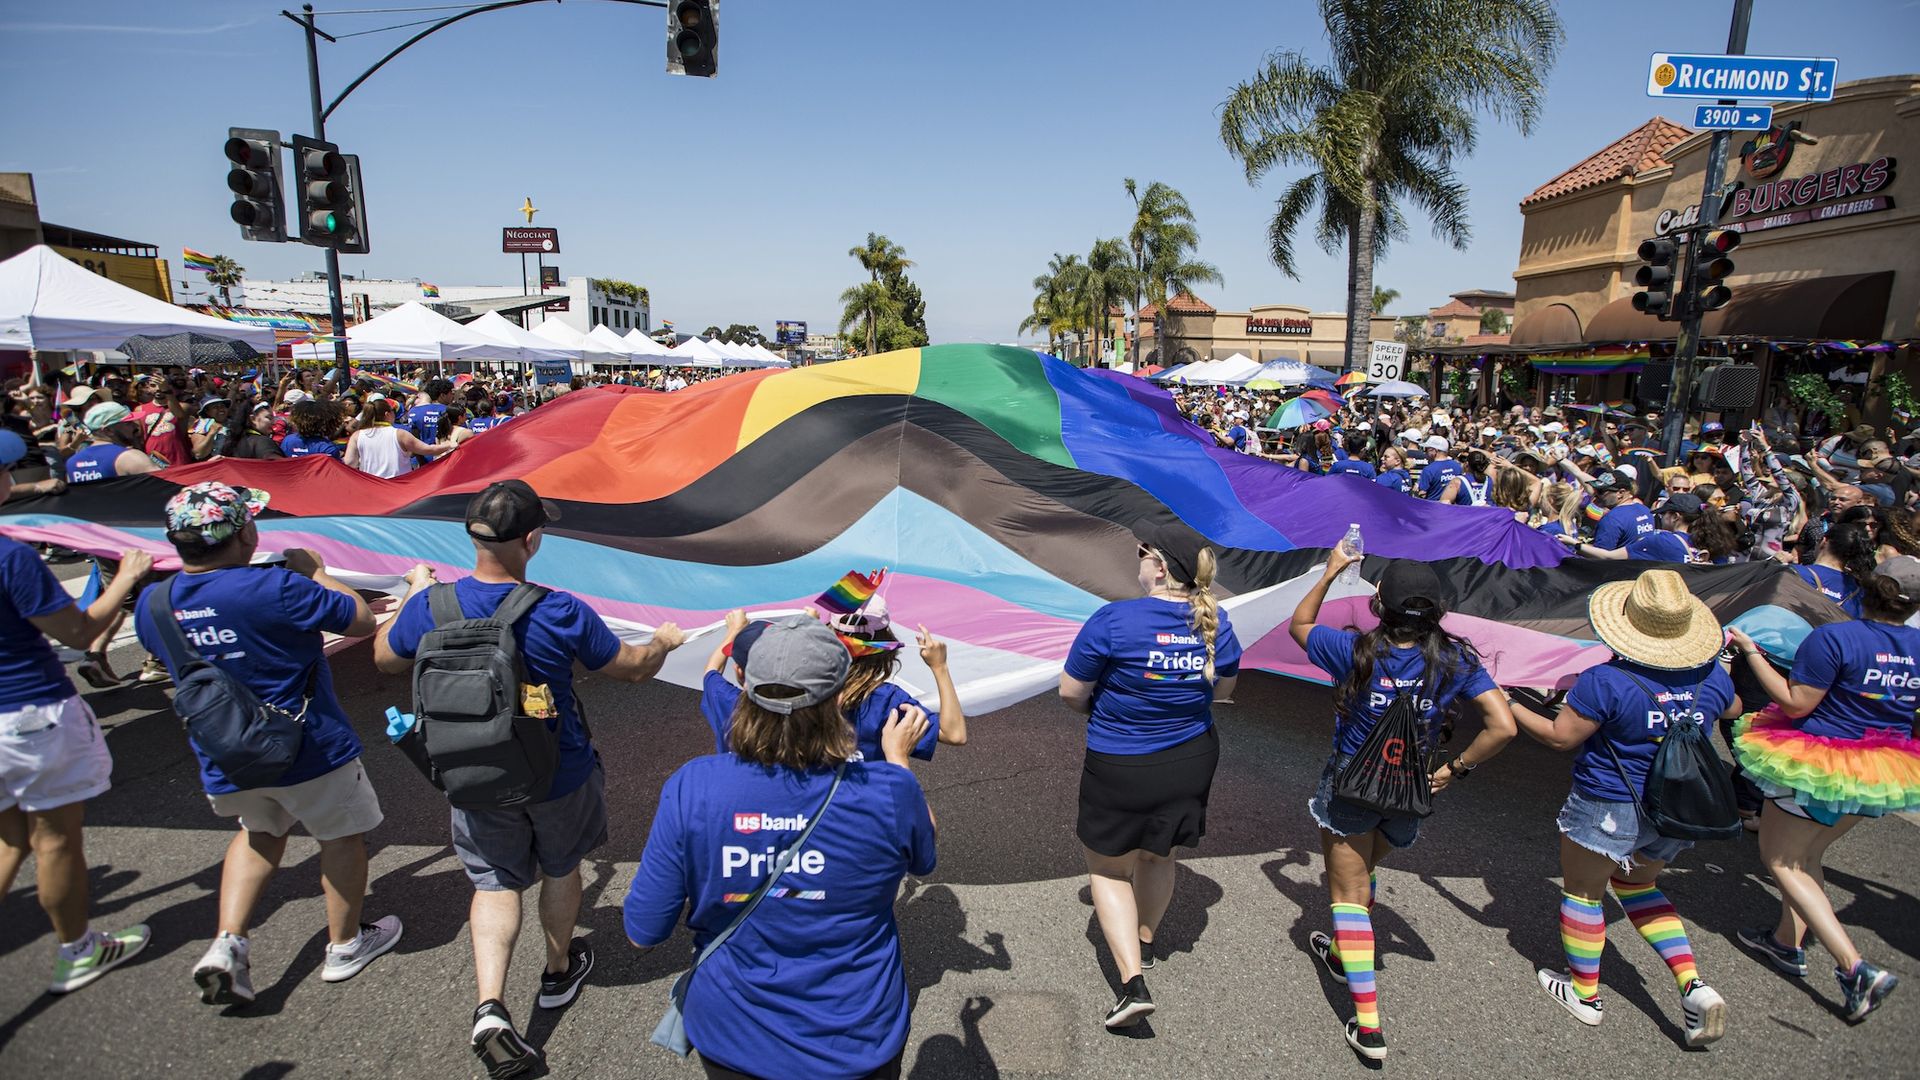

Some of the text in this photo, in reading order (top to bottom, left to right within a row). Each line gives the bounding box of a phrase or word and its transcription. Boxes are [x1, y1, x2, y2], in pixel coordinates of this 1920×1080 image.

[1678, 63, 1827, 92] RICHMOND ST.
[1702, 109, 1740, 126] 3900
[1733, 156, 1889, 217] BURGERS
[1821, 198, 1874, 218] CRAFT BEERS
[1763, 214, 1792, 228] SHAKES
[1375, 344, 1403, 354] SPEED
[1376, 353, 1399, 362] LIMIT
[1371, 362, 1398, 379] 30
[74, 471, 102, 482] Pride
[174, 606, 218, 621] sbank
[186, 626, 238, 647] ide
[1147, 650, 1204, 671] Pride
[1863, 669, 1920, 689] Pride
